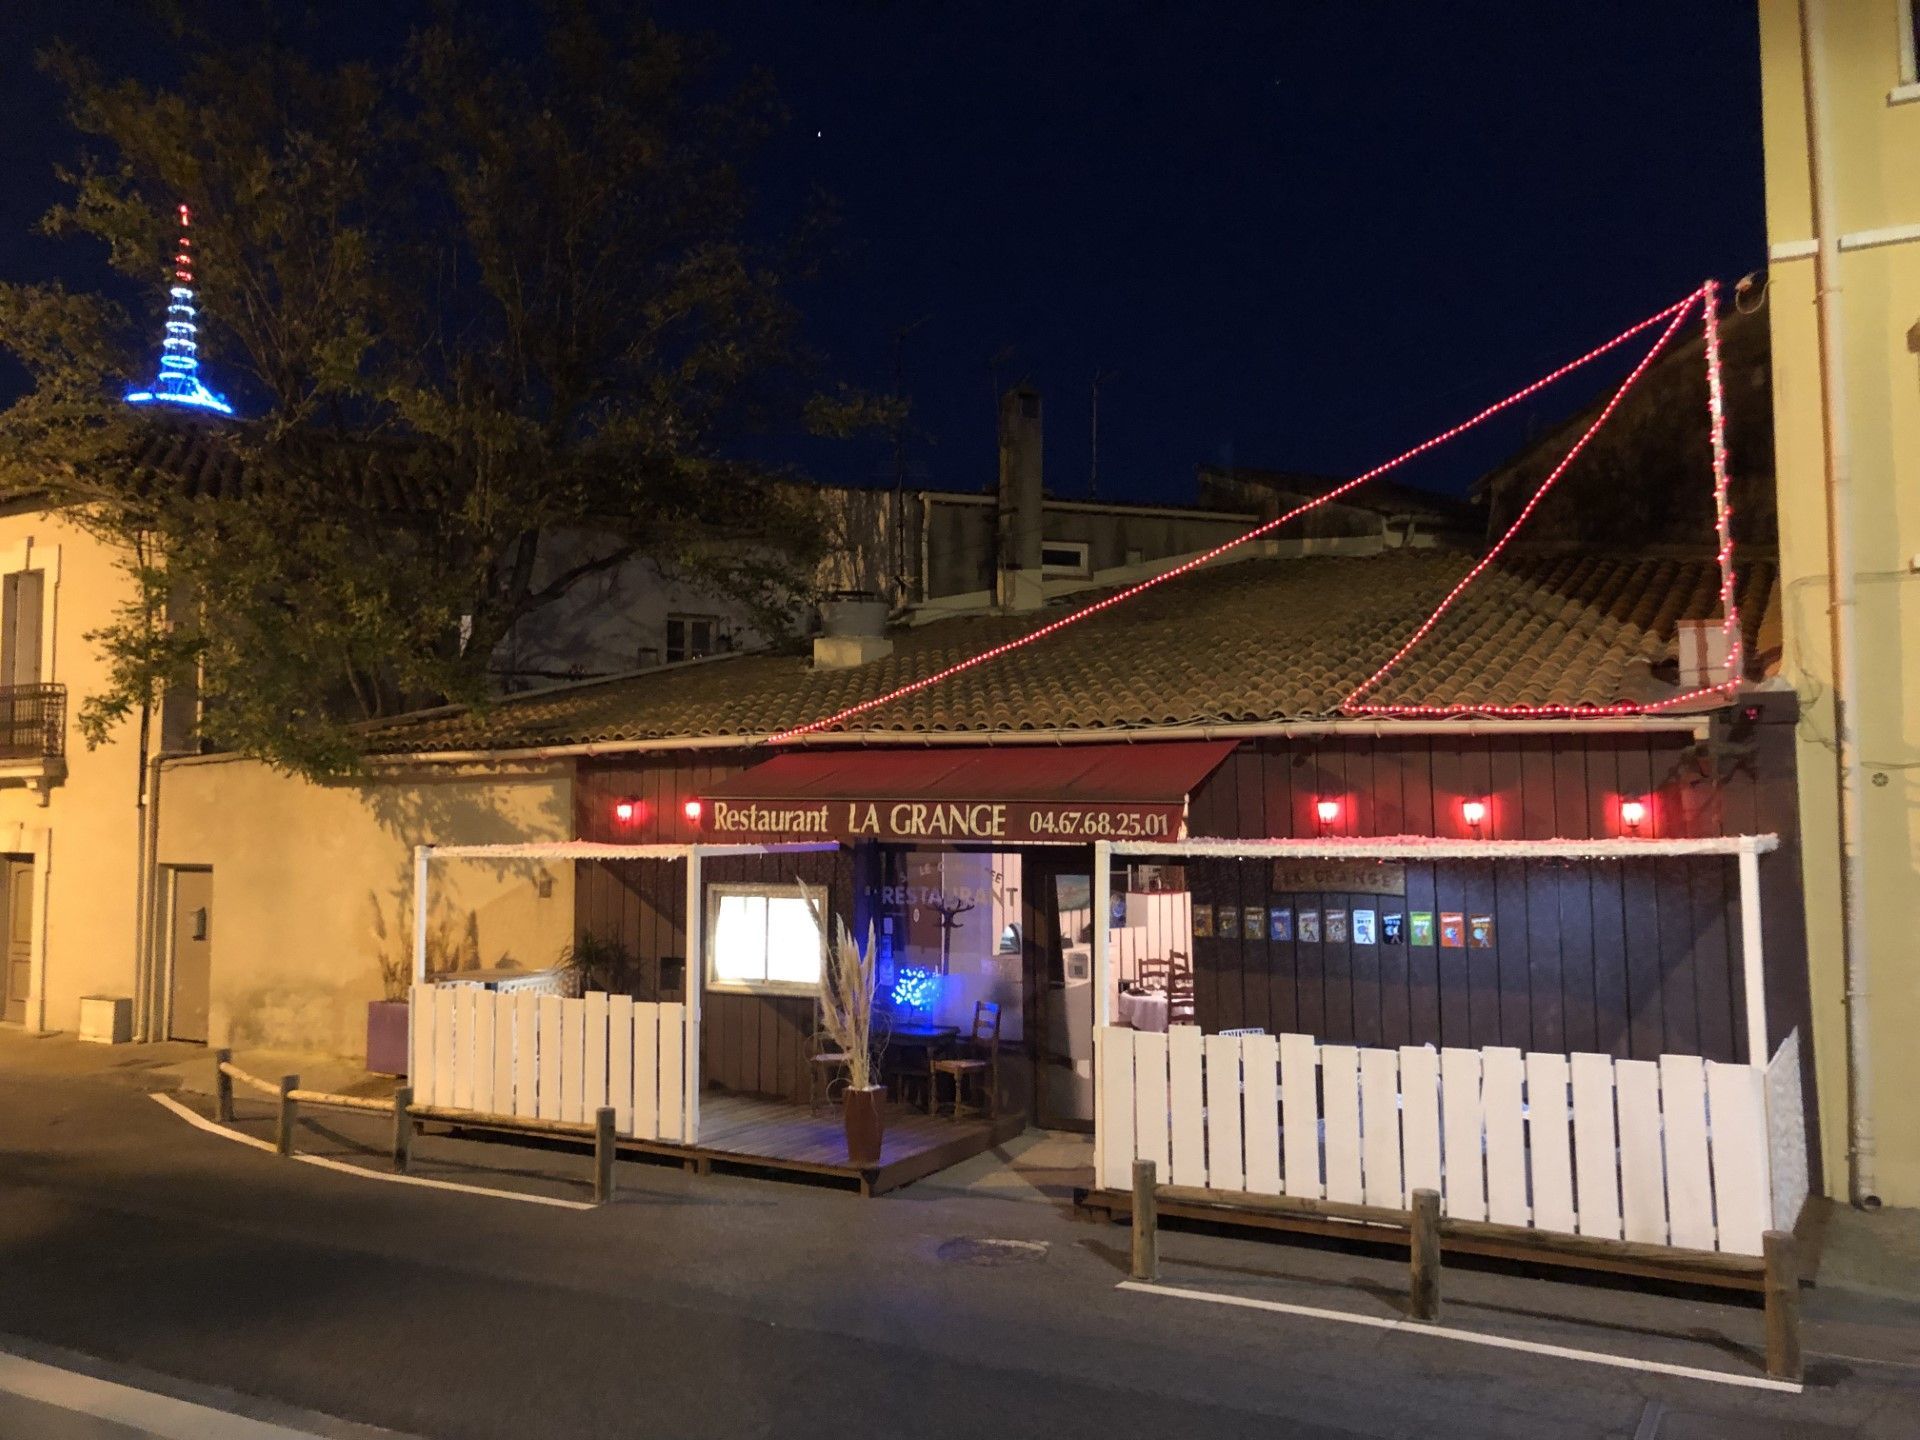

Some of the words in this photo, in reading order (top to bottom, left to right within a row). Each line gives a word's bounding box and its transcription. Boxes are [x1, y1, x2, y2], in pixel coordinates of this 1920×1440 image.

[714, 801, 829, 833] Restaurant
[848, 803, 880, 834] LA
[890, 803, 1007, 836] GRANGE
[1029, 811, 1169, 837] 04.67.68.25.01
